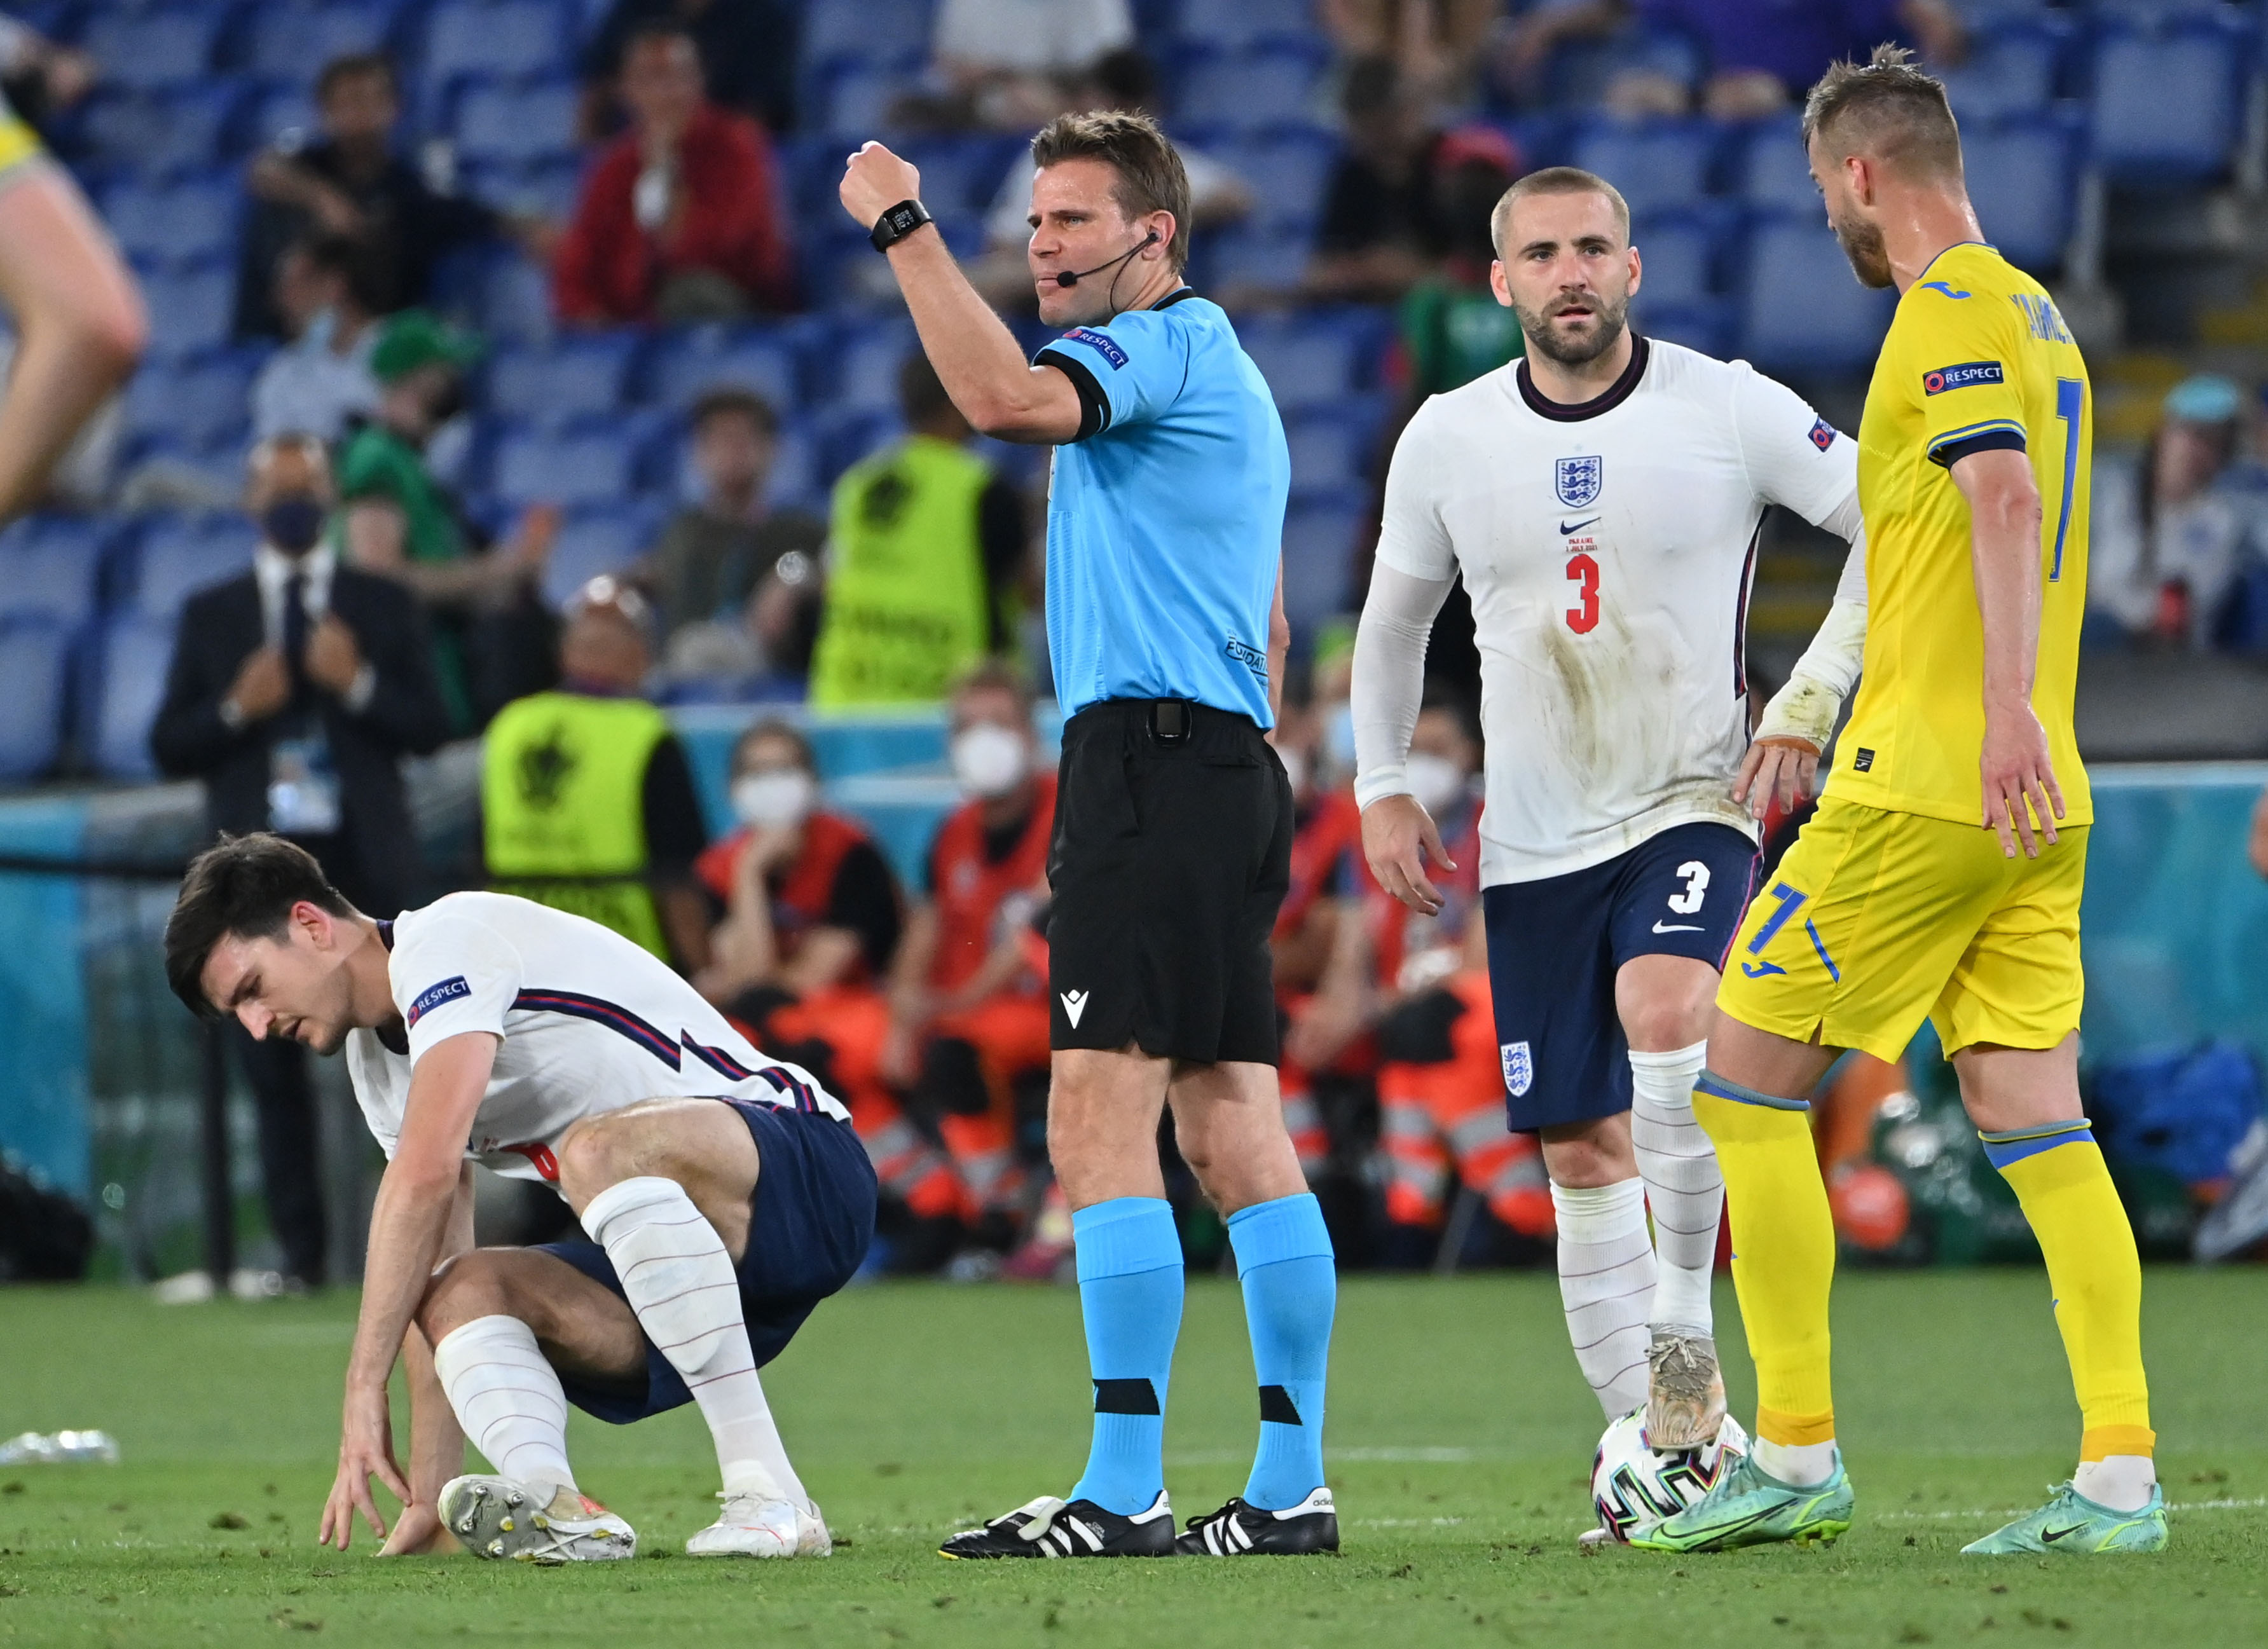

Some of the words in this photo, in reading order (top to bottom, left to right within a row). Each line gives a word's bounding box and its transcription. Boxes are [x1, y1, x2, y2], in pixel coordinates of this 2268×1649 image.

[1079, 332, 1125, 365] RESPECT
[1946, 367, 2002, 383] RESPECT
[2049, 376, 2084, 582] 7
[1566, 553, 1599, 634] 3
[1667, 860, 1711, 914] 3
[1745, 880, 1809, 956] 7
[417, 980, 467, 1011] RESPECT
